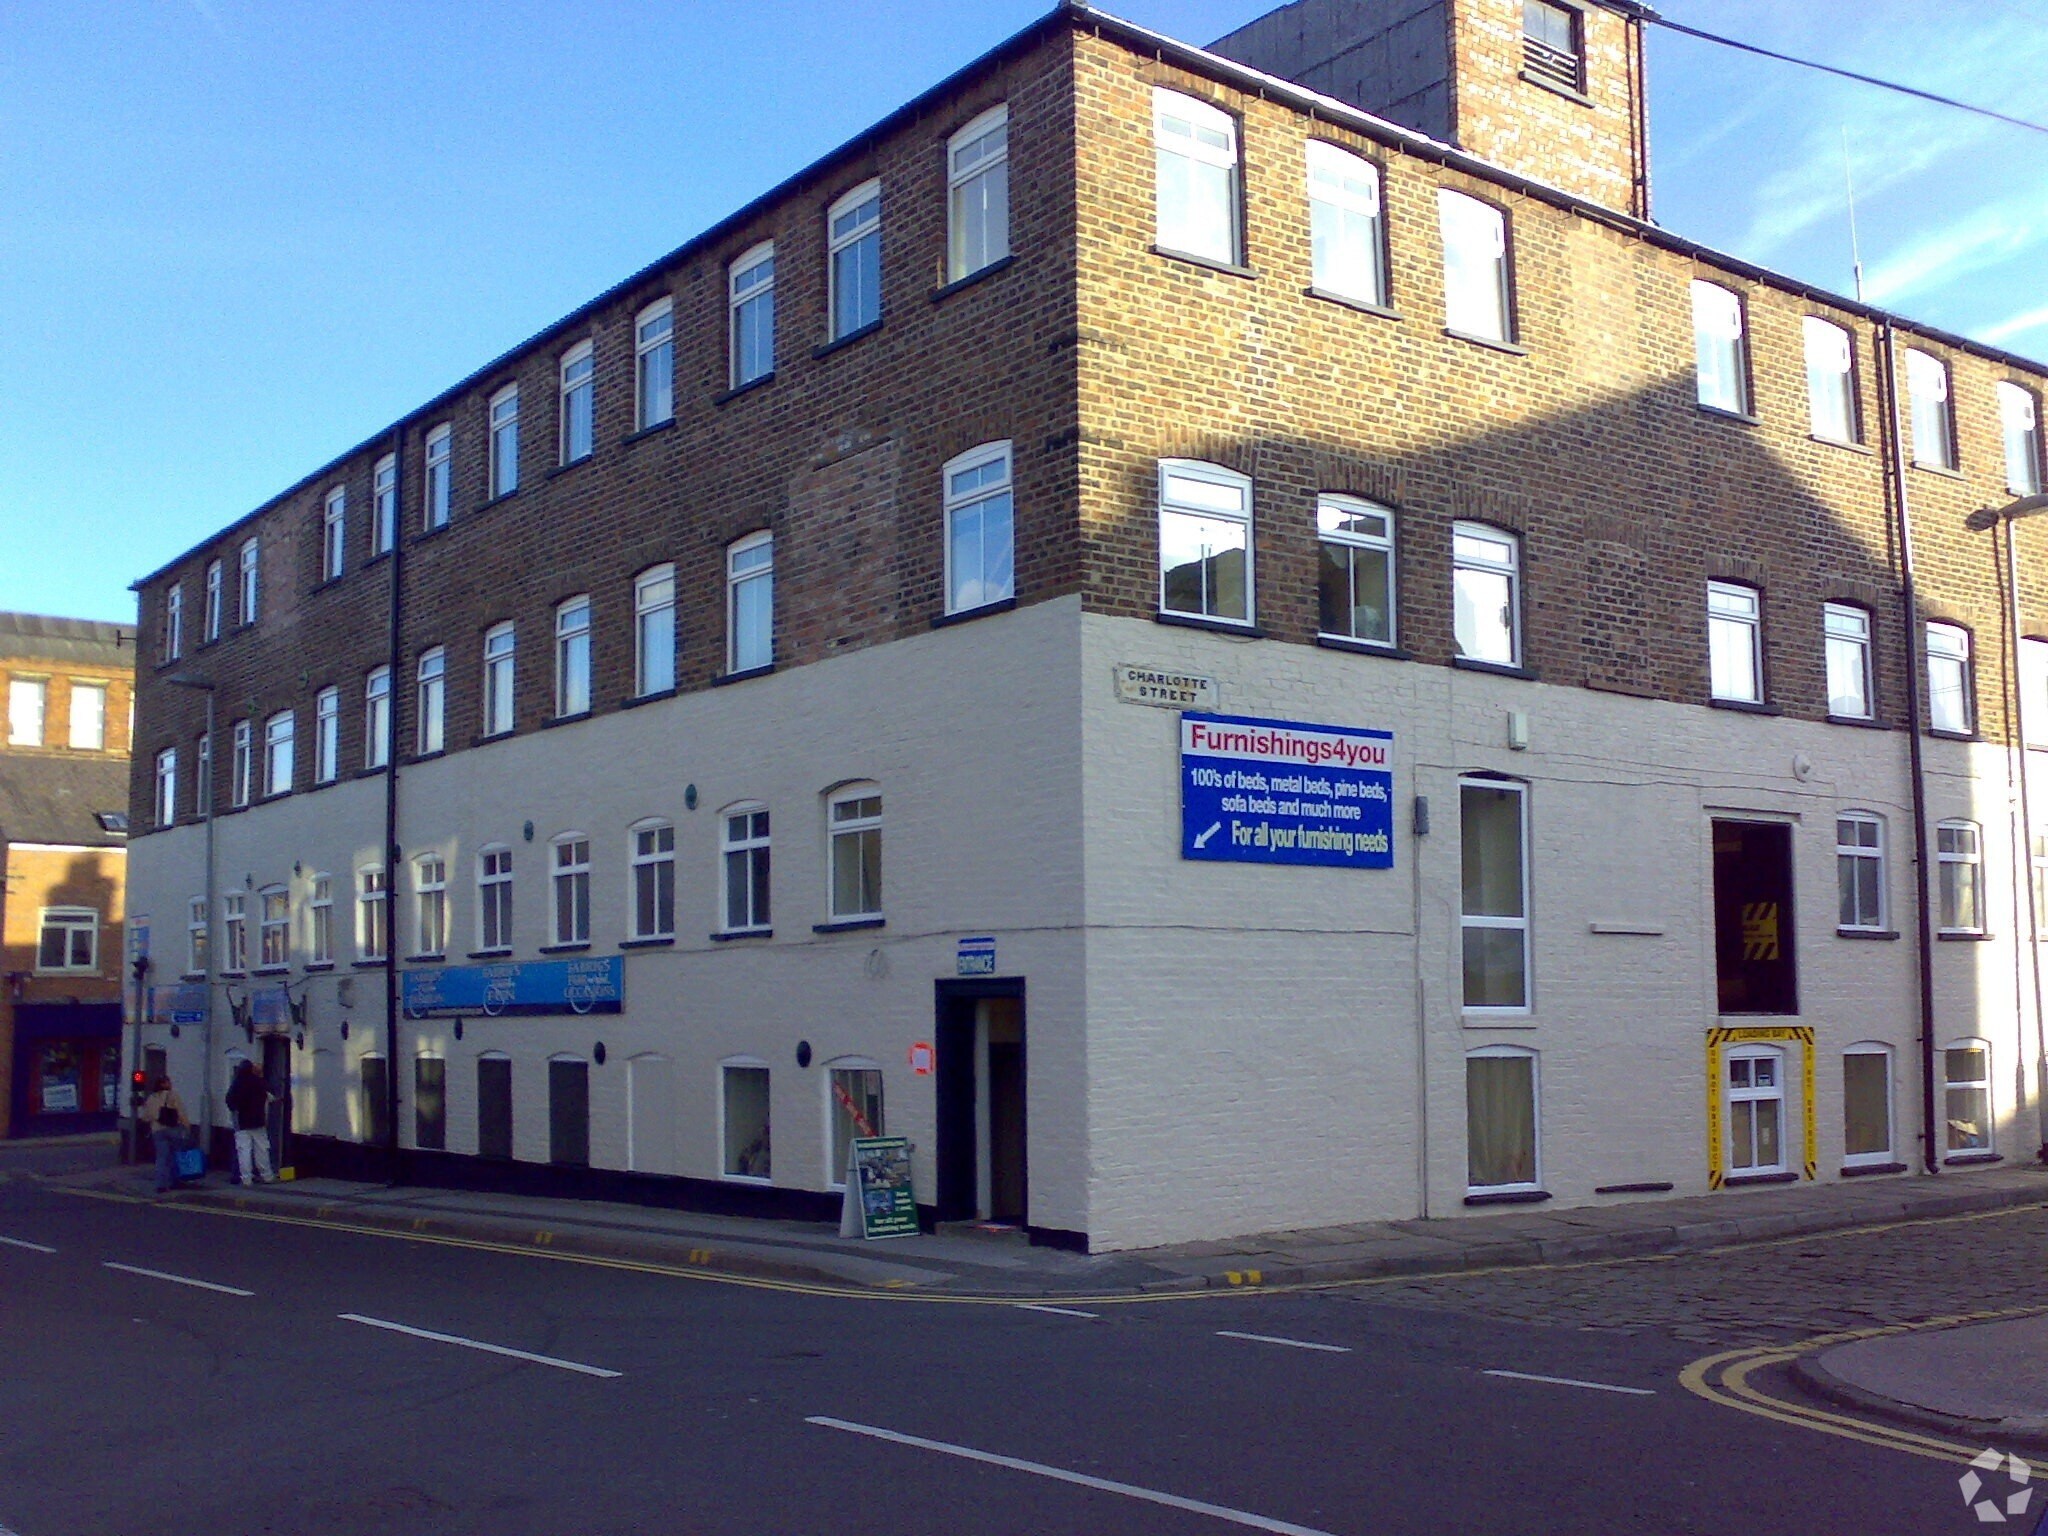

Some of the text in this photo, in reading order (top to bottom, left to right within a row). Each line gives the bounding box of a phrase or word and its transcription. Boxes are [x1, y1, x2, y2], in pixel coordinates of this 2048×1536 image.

[1128, 670, 1207, 690] CHARLOTTE
[1139, 686, 1197, 702] STREET
[1191, 724, 1385, 766] Furnishings4you
[1191, 767, 1387, 803] 100's of beds, metal beds, pine beds,
[1222, 794, 1361, 820] sofa beds and much more
[1231, 820, 1388, 856] For all your furnishing needs
[1738, 1028, 1771, 1039] LOADING
